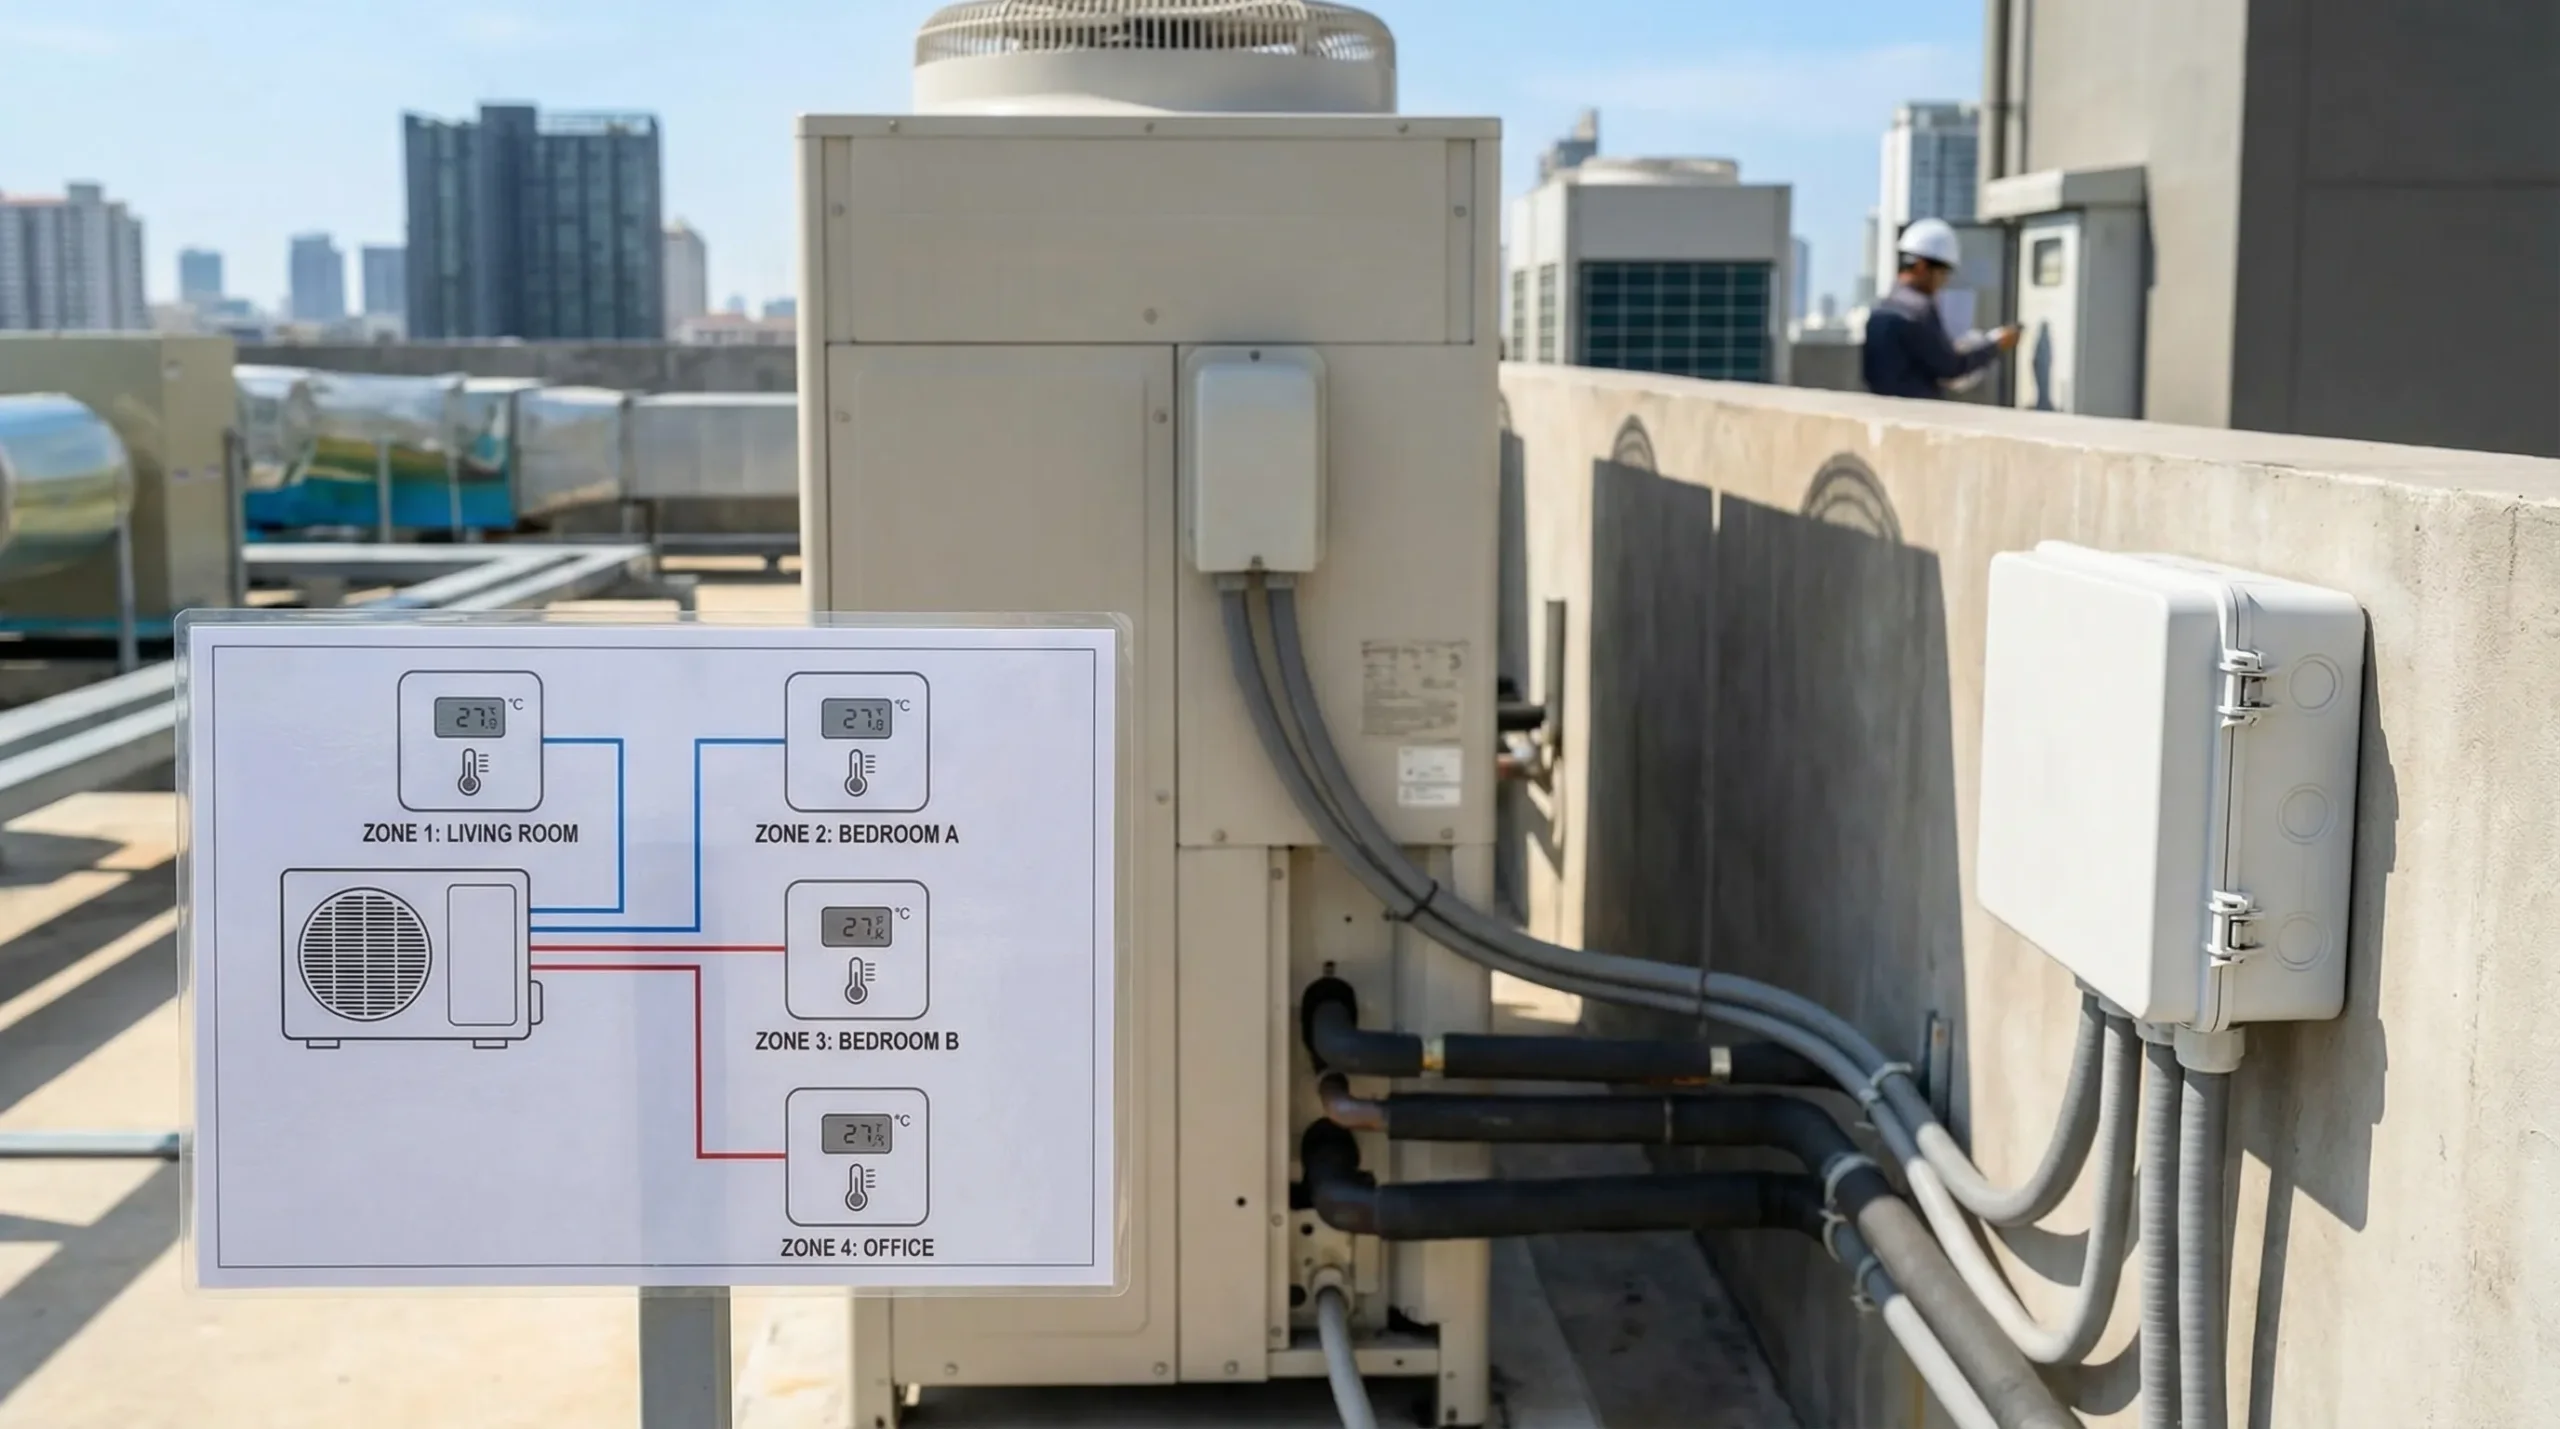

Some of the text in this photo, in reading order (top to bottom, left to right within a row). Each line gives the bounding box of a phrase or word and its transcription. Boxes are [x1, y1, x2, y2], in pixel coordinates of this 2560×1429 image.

[363, 823, 578, 843] ZONE 1: LIVING ROOM
[755, 824, 960, 844] ZONE 2: BEDROOM A
[895, 907, 910, 920] °C
[755, 1031, 960, 1051] ZONE 3: BEDROOM B
[780, 1238, 935, 1258] ZONE 4: OFFICE
